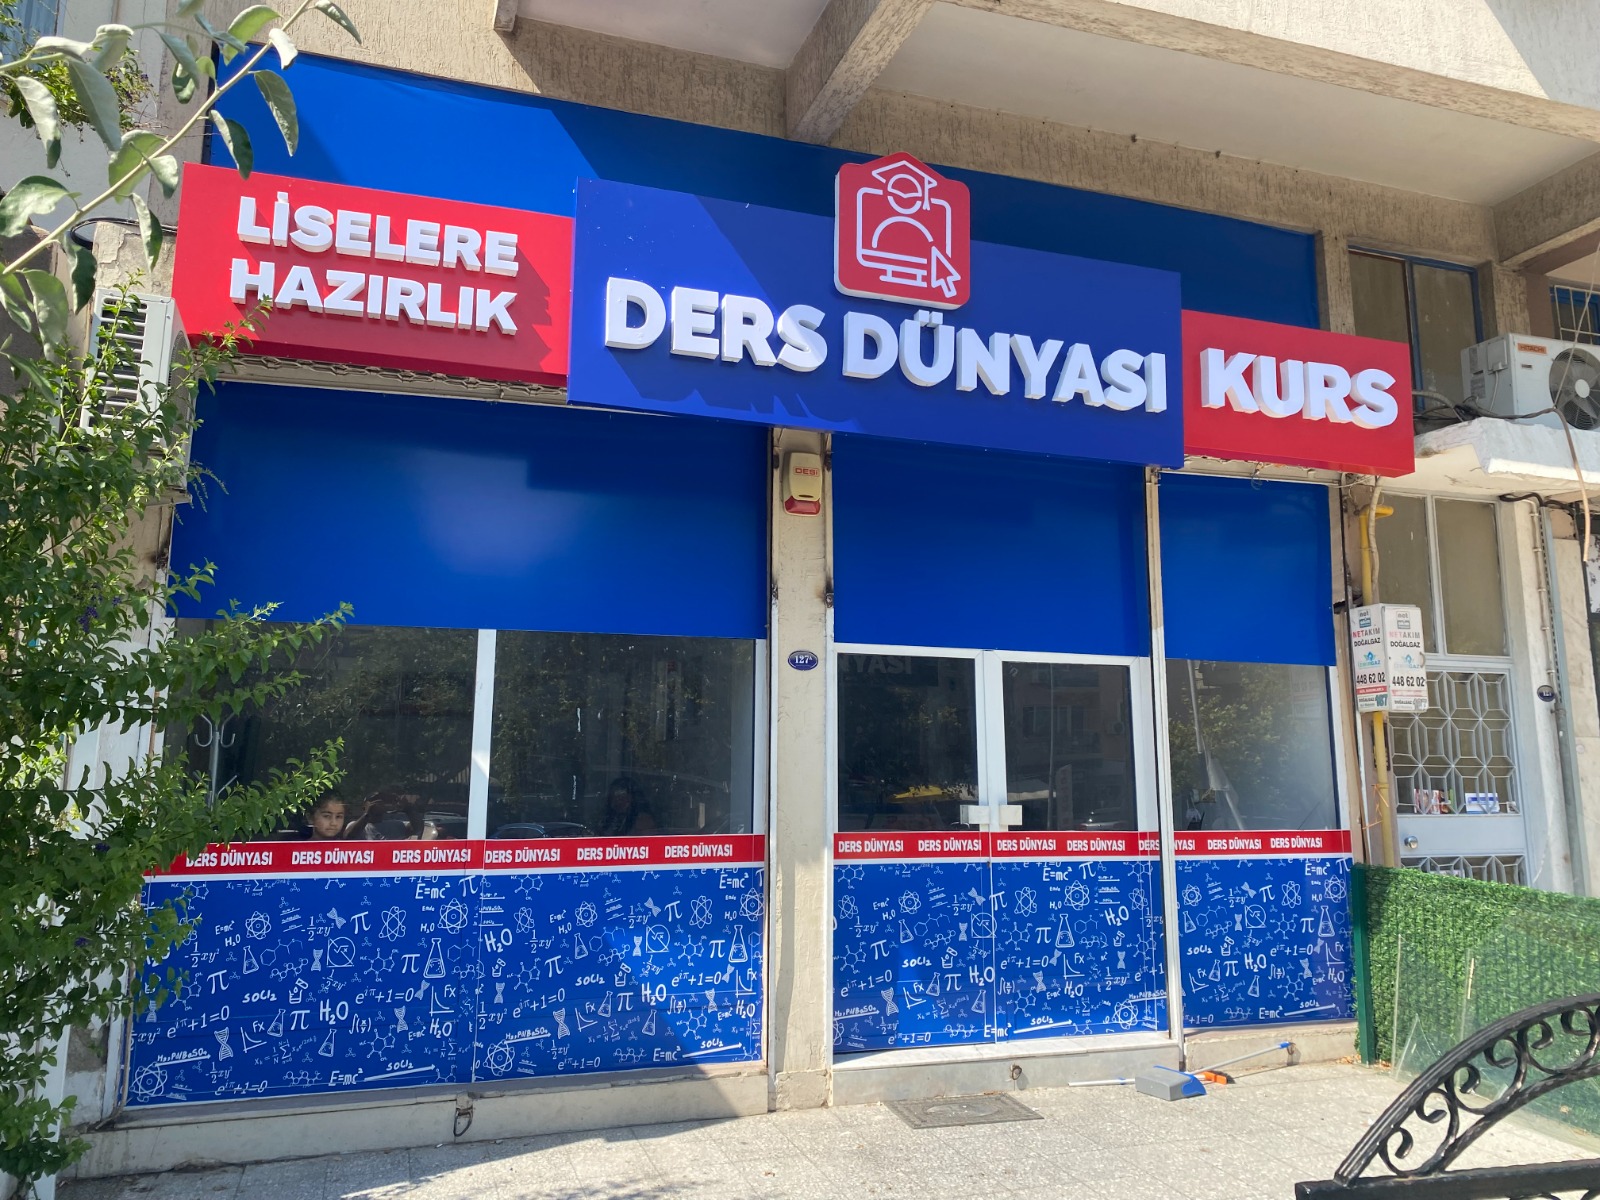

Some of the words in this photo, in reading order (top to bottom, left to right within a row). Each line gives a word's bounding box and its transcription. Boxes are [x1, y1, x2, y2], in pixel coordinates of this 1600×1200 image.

[237, 191, 519, 277] LİSELERE
[229, 258, 518, 336] HAZIRLIK
[605, 276, 827, 372] DERS
[842, 310, 1167, 413] DÜNYASI
[1200, 347, 1398, 429] KURS
[1390, 640, 1421, 648] DOĞALGAZ
[1356, 674, 1368, 685] 448
[1368, 673, 1377, 684] 62
[1377, 671, 1386, 683] 02
[1392, 675, 1405, 686] 448
[1406, 676, 1415, 687] 62
[1416, 677, 1425, 687] 02
[838, 841, 862, 853] DERS
[864, 837, 904, 852] DÜNYASI
[918, 840, 942, 852] DERS
[944, 837, 982, 851] DÜNYASI
[997, 840, 1018, 851] DERS
[1020, 836, 1056, 851] DÜNYASI
[1066, 839, 1089, 852] DERS
[1090, 836, 1125, 851] DÜNYASI
[1139, 839, 1160, 851] DERS
[1207, 838, 1227, 850] DERS
[1228, 836, 1262, 850] DÜNYASI
[1270, 837, 1290, 849] DERS
[1291, 835, 1322, 848] DÜNYASI
[220, 849, 272, 866] DÜNYASI
[291, 851, 322, 865] DERS
[324, 847, 374, 865] DÜNYASI
[392, 850, 421, 864] DERS
[423, 846, 471, 863] DÜNYASI
[485, 850, 512, 863] DERS
[515, 847, 560, 862] DÜNYASI
[577, 847, 603, 861] DERS
[606, 844, 649, 860] DÜNYASI
[664, 845, 690, 859] DERS
[692, 842, 733, 858] DÜNYASI
